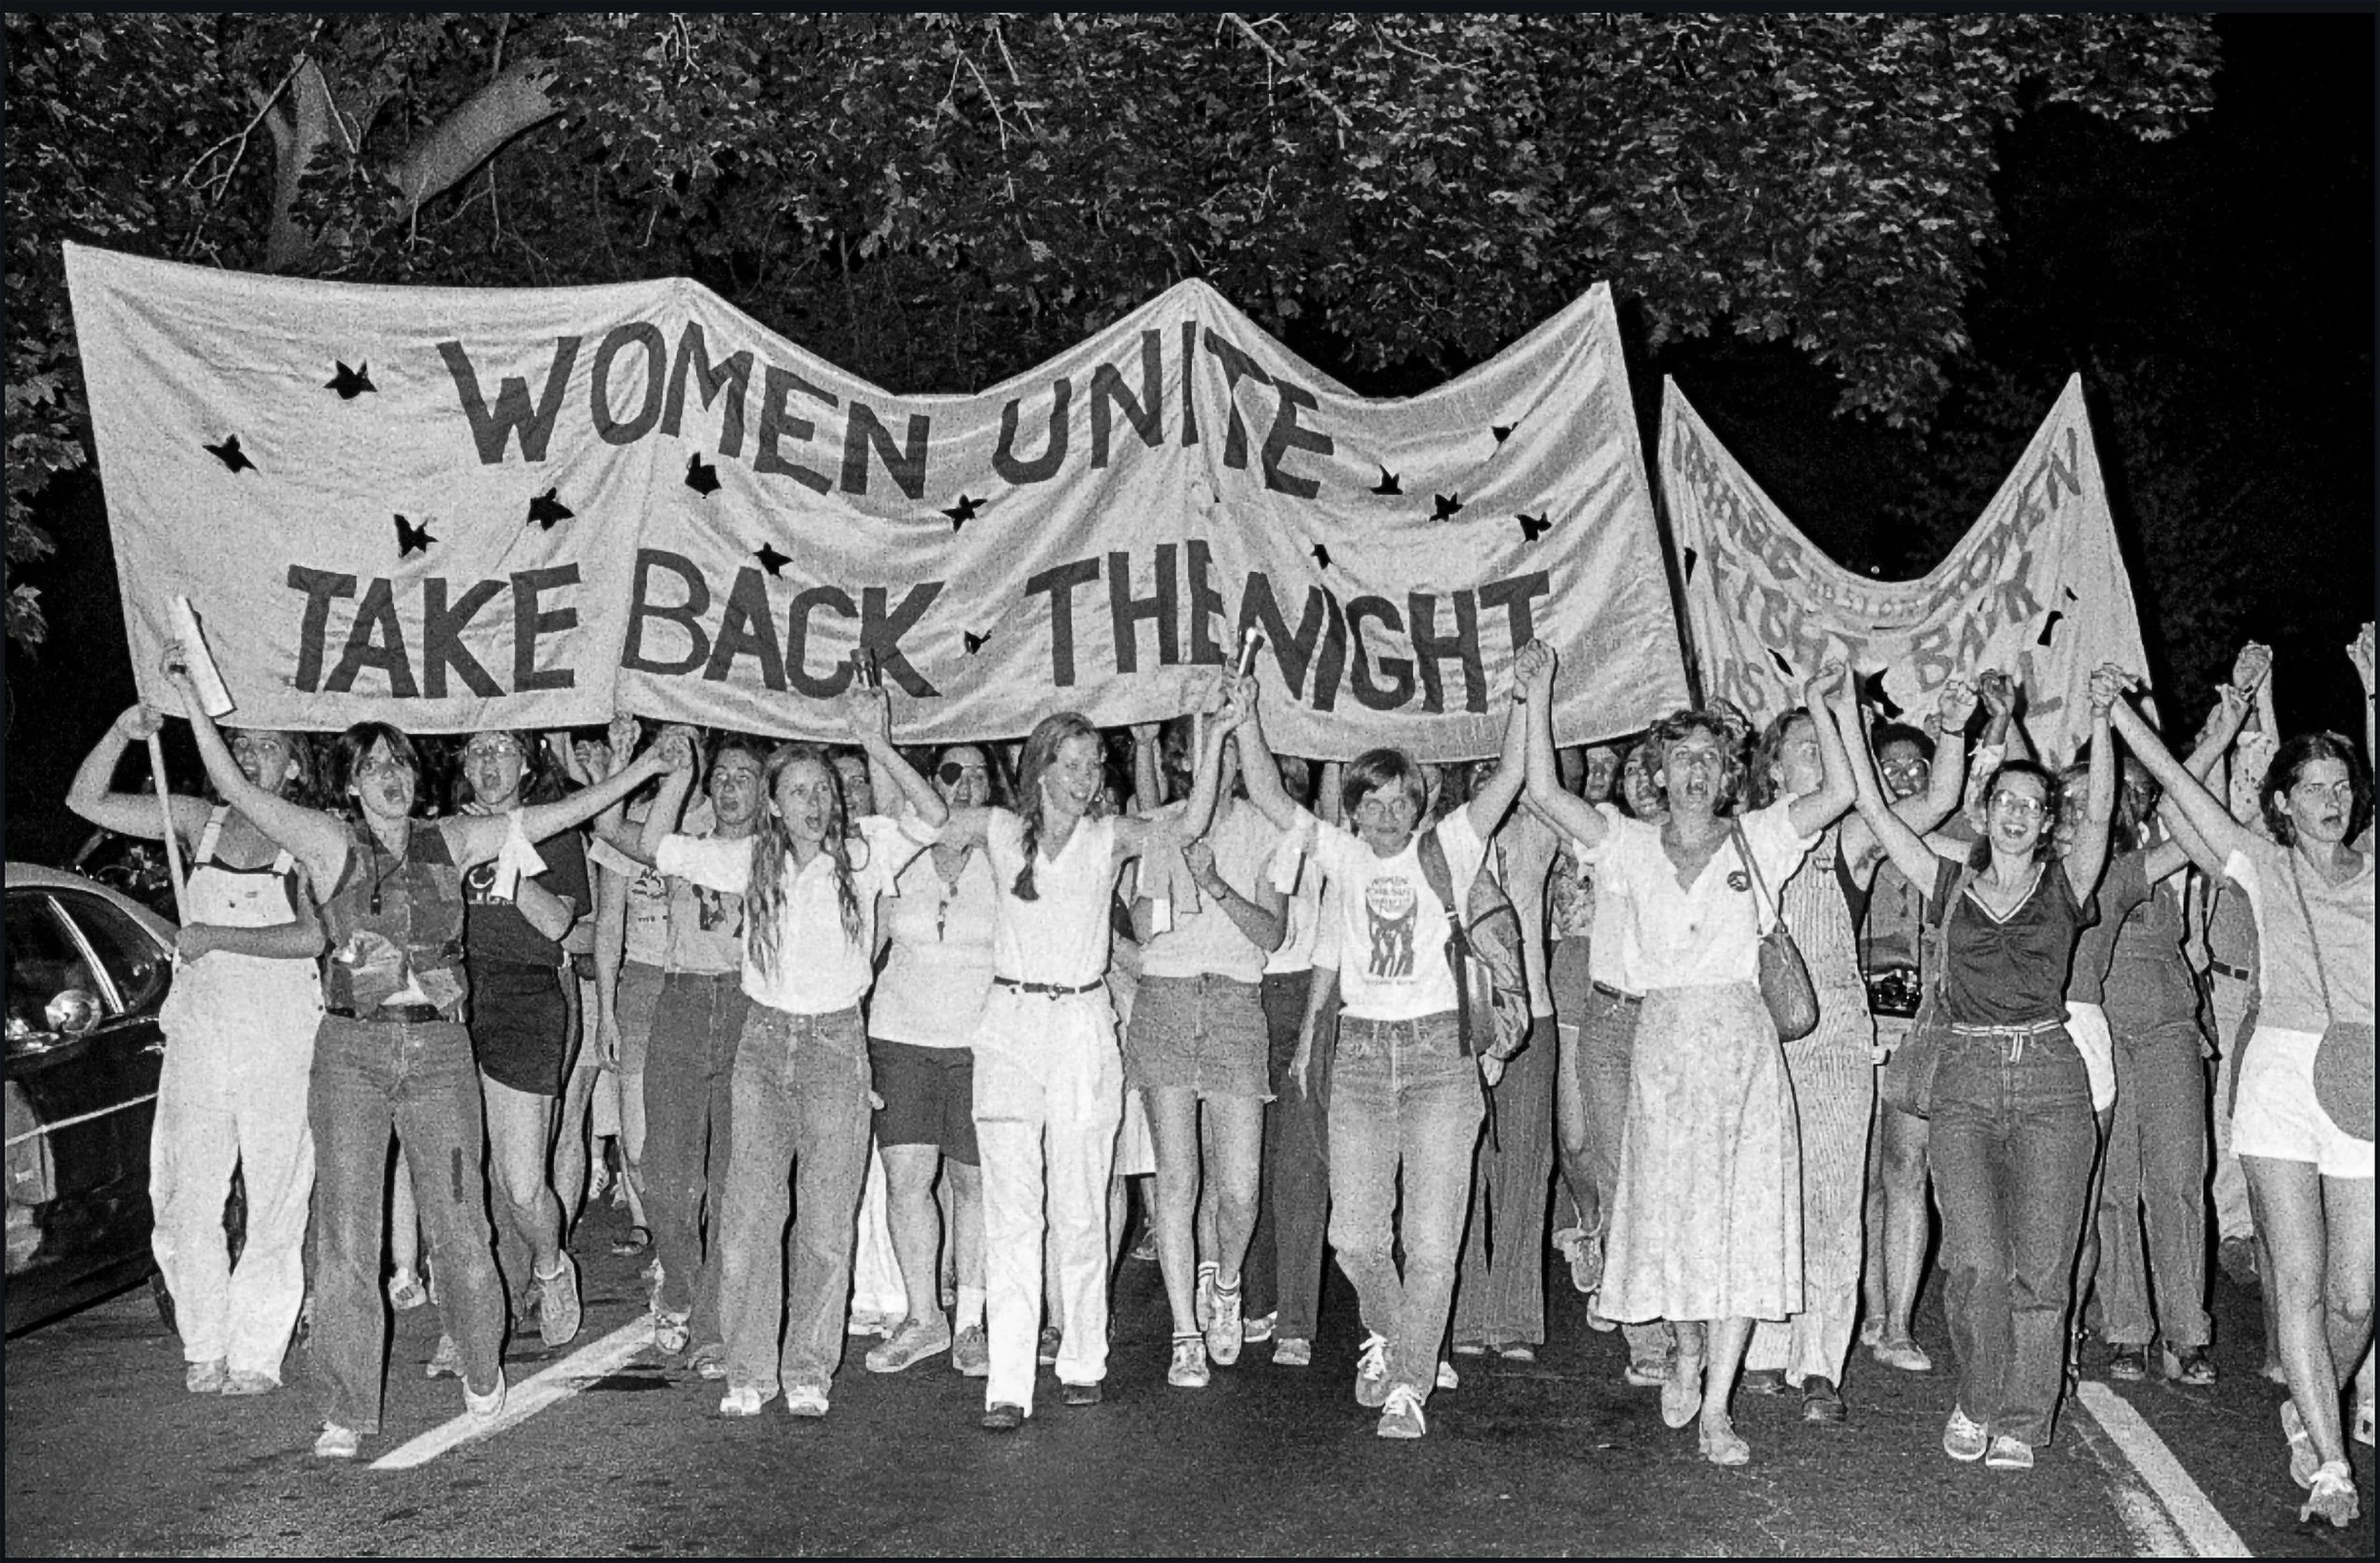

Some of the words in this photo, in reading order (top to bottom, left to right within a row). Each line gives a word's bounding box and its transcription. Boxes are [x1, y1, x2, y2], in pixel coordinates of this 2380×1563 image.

[436, 320, 930, 500] WOMEN
[992, 321, 1334, 499] UNITE
[287, 562, 581, 699] TAKE
[621, 547, 945, 700] BACK
[1024, 539, 1227, 687] THE
[1238, 570, 1550, 714] NIGHT
